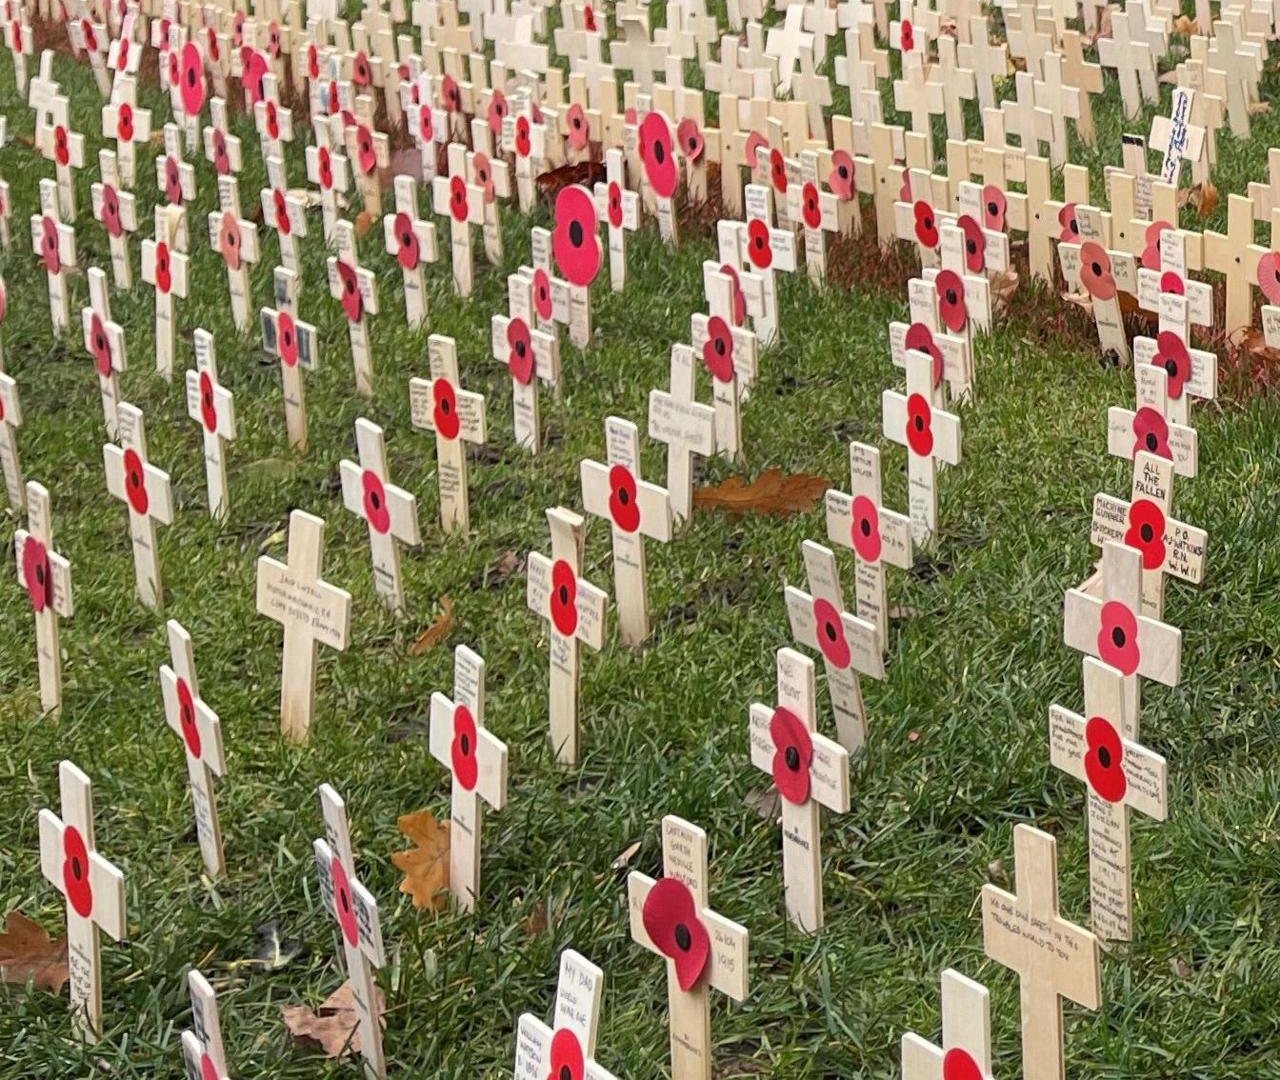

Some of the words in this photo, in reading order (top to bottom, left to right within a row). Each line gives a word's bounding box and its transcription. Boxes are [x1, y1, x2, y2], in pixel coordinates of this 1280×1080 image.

[1143, 461, 1161, 476] ALL
[1143, 472, 1160, 487] THE
[1135, 481, 1166, 499] FALLEN
